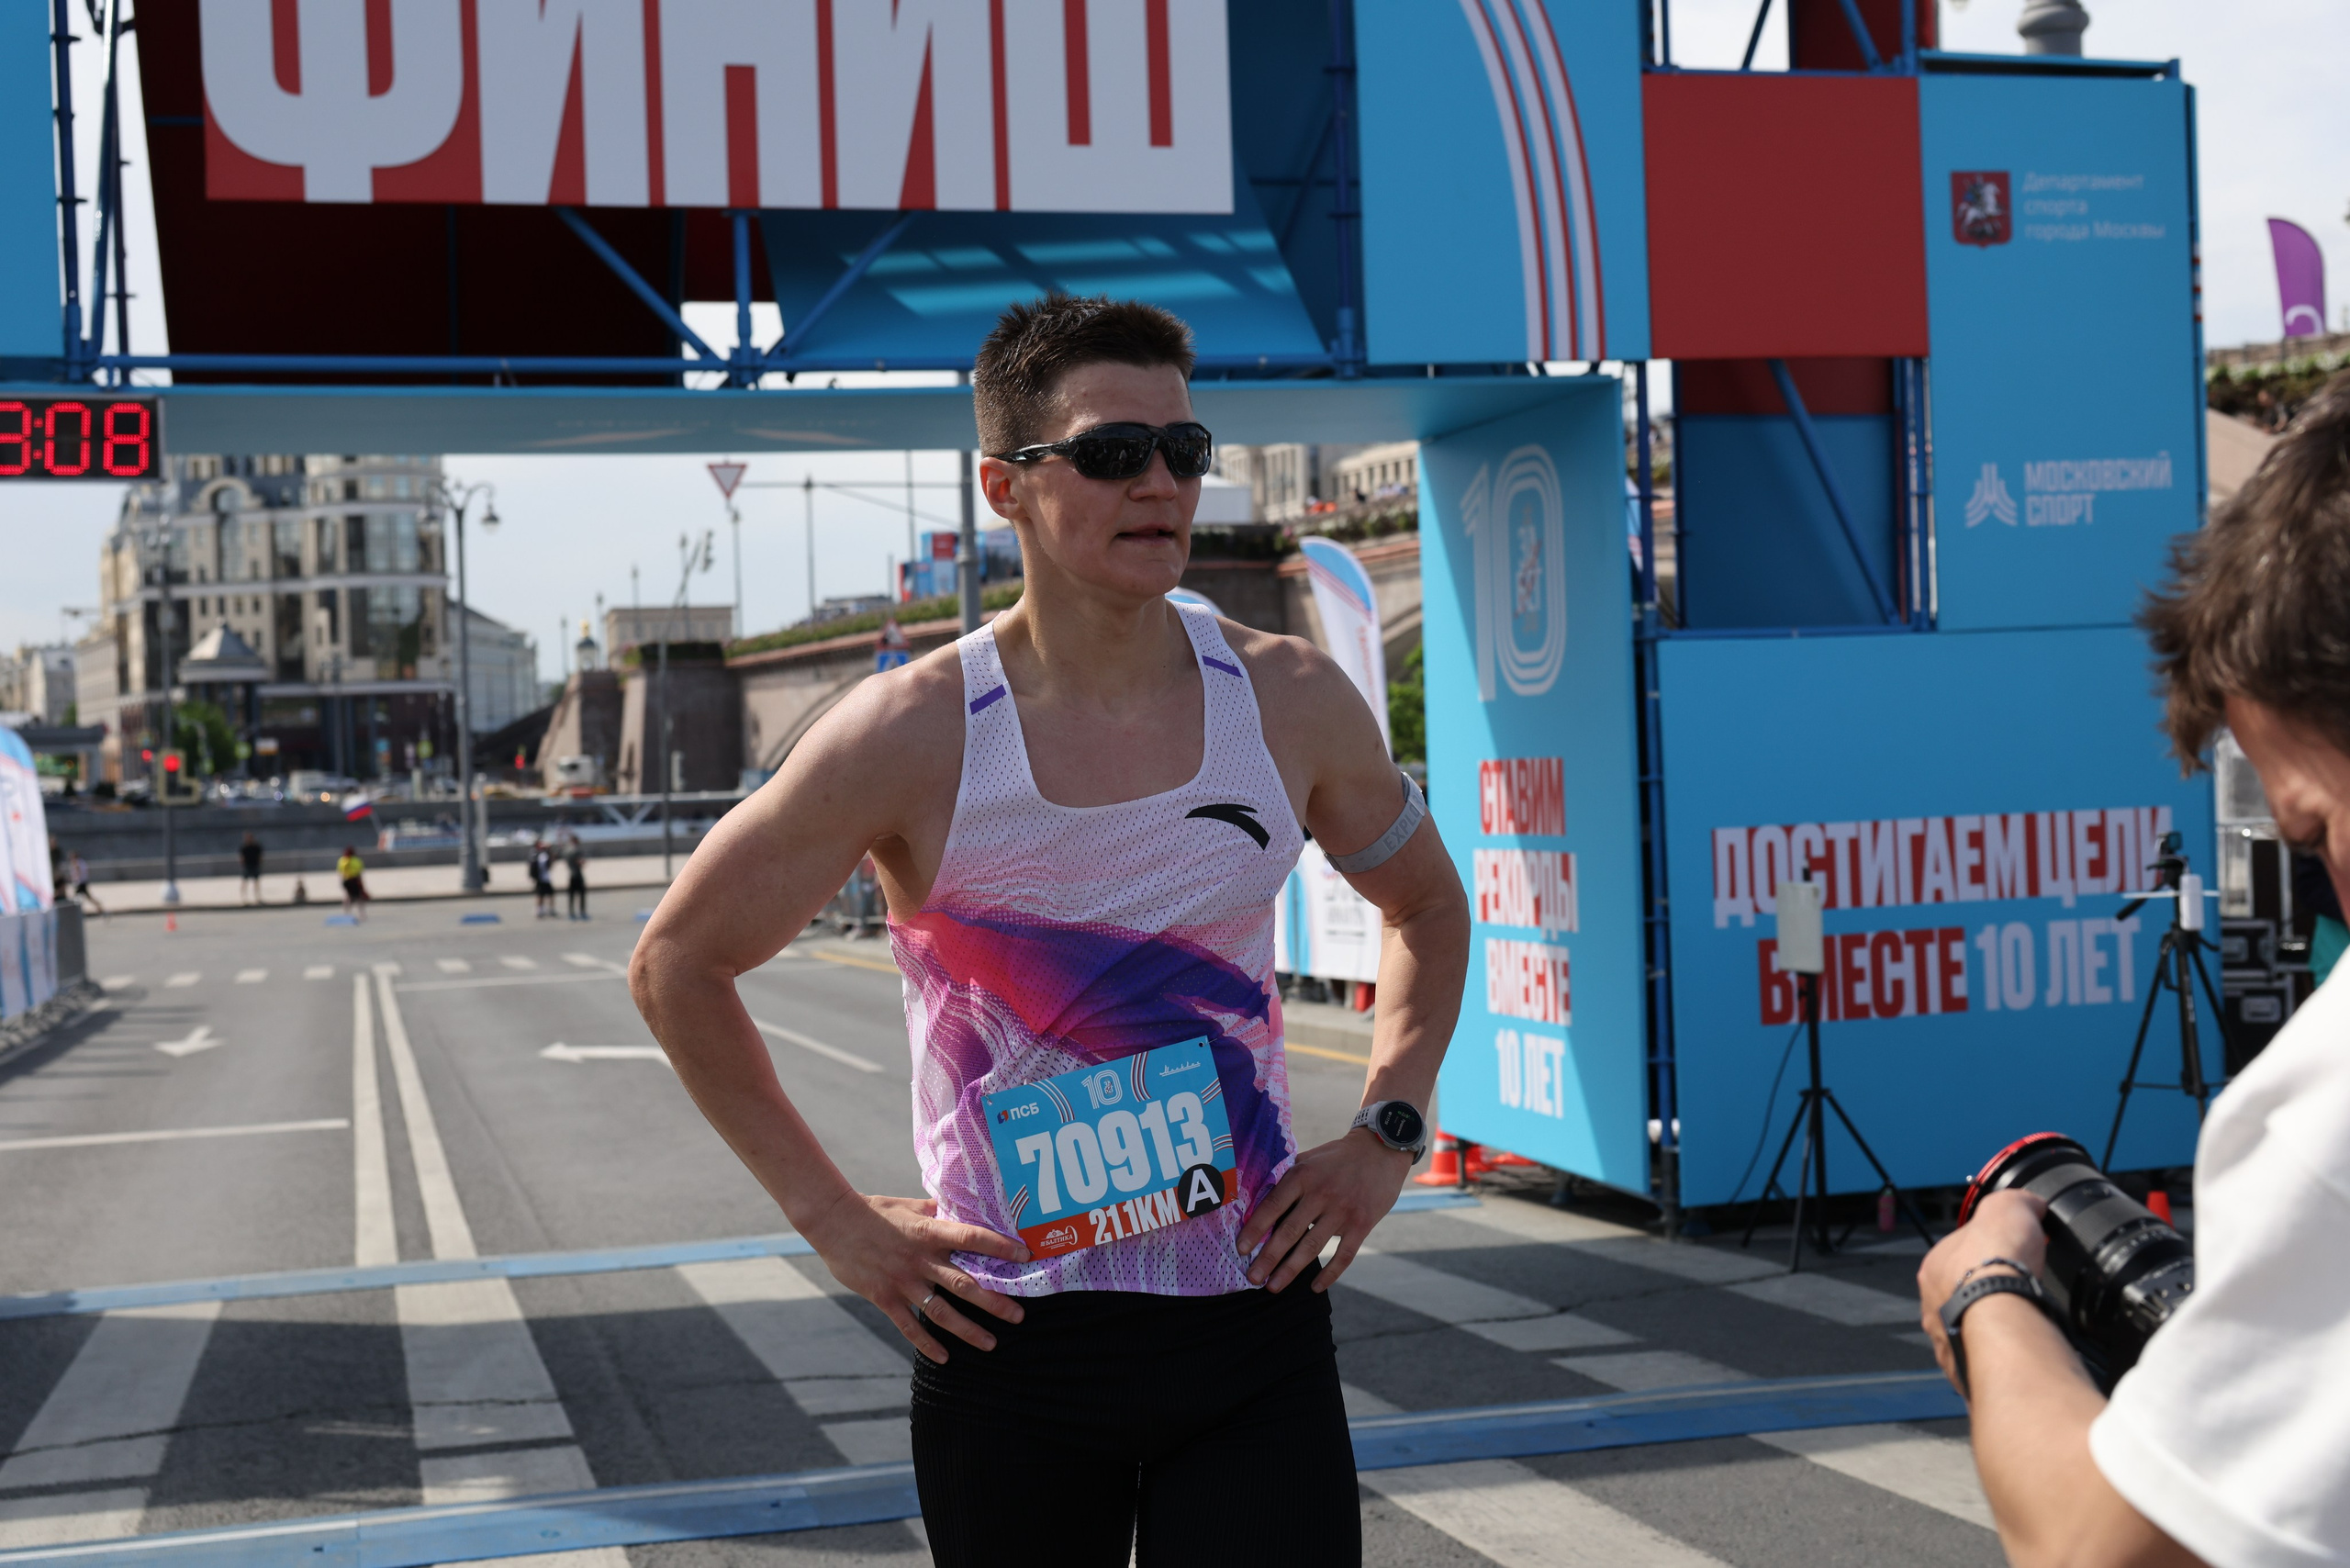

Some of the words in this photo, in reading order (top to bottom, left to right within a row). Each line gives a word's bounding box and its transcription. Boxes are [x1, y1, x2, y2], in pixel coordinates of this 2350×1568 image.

[2024, 450, 2173, 492] МОСКОВСКИЙ
[2025, 493, 2096, 527] СПОРТ
[1460, 442, 1566, 702] 10
[1479, 756, 1566, 837] СТАВИМ
[1472, 847, 1580, 941] РЕКОРДЫ
[1713, 812, 2028, 928] ДОСТИГАЕМ
[1485, 937, 1572, 1027] ВМЕСТЕ
[1975, 922, 2037, 1011] 10
[2045, 917, 2141, 1006] ЛЕТ
[1010, 1103, 1039, 1120] ПСБ
[1495, 1028, 1523, 1110] 10
[1523, 1031, 1565, 1120] ЛЕТ
[1015, 1092, 1214, 1215] 70913
